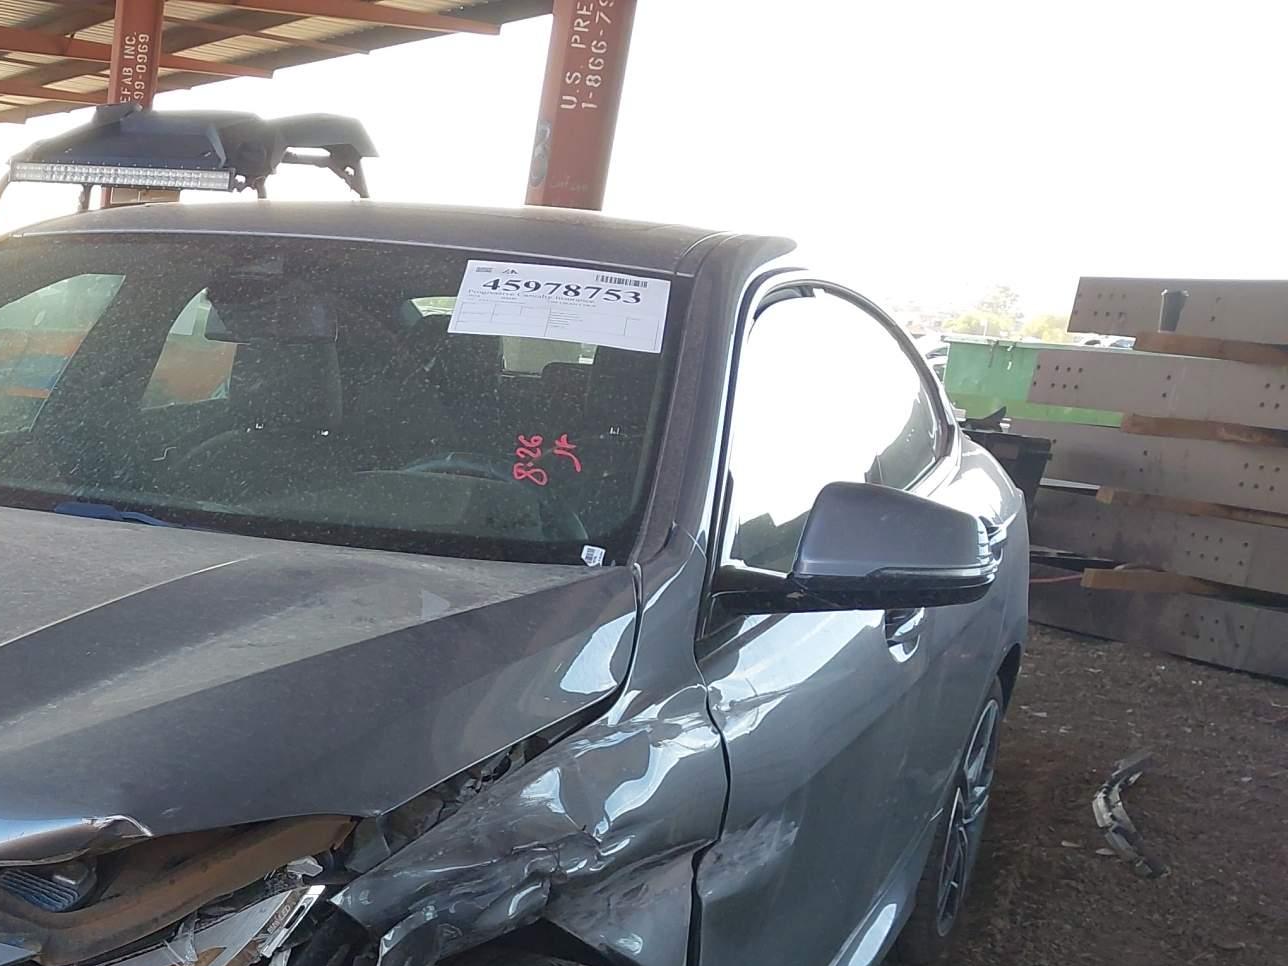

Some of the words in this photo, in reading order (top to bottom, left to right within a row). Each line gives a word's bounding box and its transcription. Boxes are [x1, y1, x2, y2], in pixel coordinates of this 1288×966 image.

[123, 32, 137, 59] INC.
[119, 67, 133, 104] EFAB
[482, 278, 642, 304] 45978753
